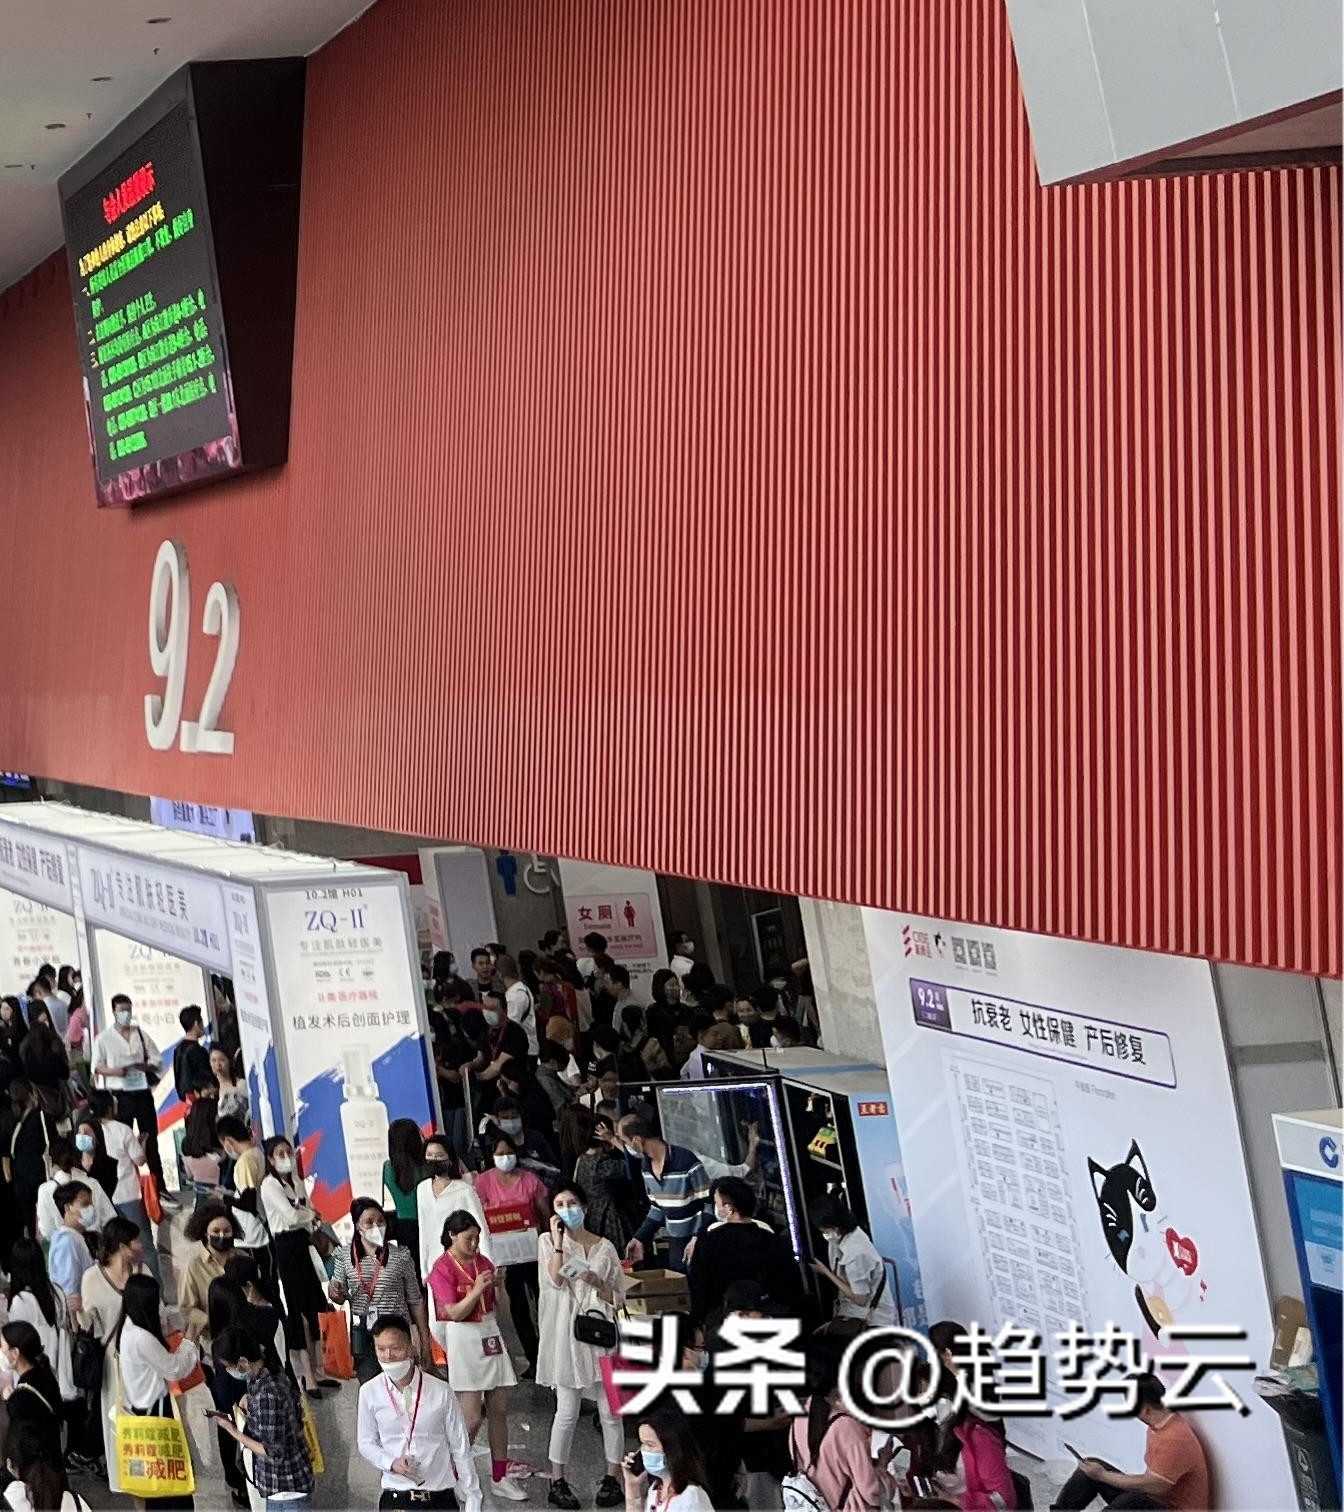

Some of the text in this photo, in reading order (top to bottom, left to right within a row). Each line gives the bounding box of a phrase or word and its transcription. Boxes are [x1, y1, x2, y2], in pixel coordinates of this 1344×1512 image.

[293, 1010, 411, 1030] 植发术后创面护理
[972, 998, 1146, 1066] 抗衰老 女性保健 产后修复
[146, 1458, 187, 1481] 减肥
